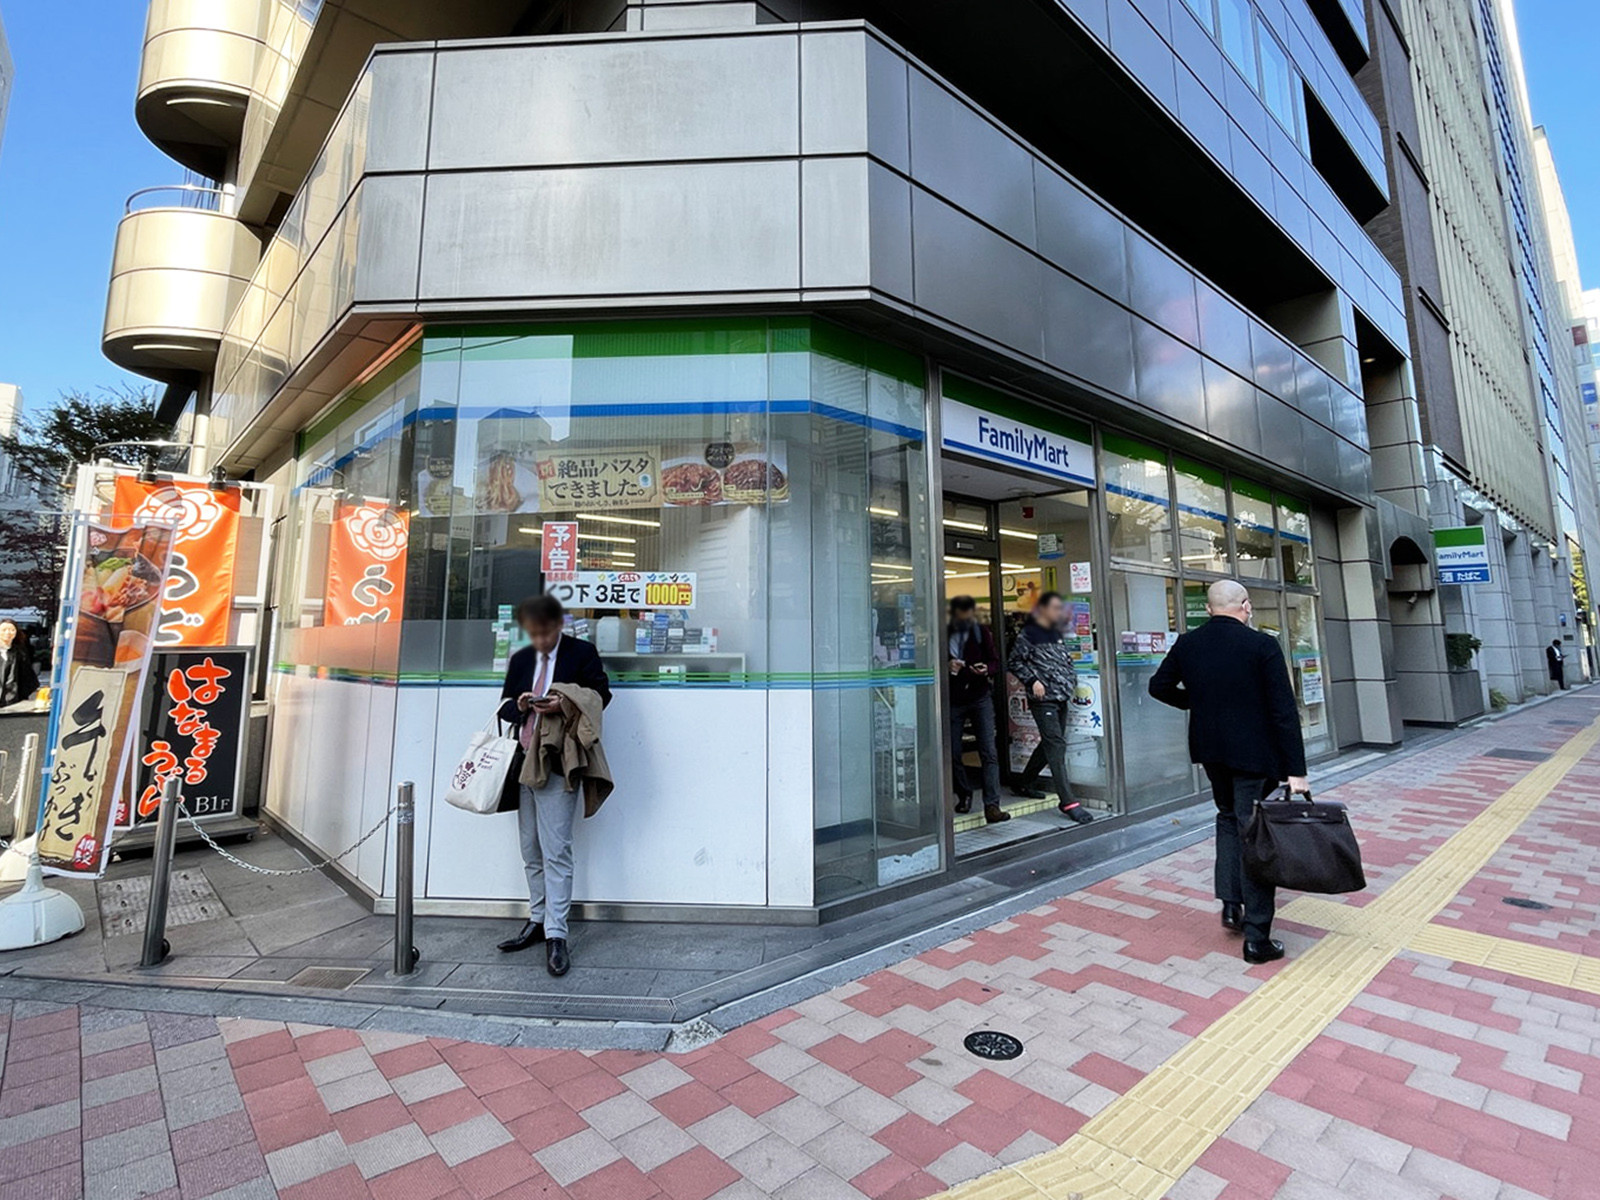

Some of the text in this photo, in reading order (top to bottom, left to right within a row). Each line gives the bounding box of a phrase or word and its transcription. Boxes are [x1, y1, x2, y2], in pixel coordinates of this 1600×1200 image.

[978, 415, 1069, 468] FamilyMart
[557, 459, 649, 478] 絶品パスタ
[548, 479, 645, 499] できました。
[548, 525, 572, 571] 予告
[1438, 551, 1484, 559] amilyMart
[1456, 571, 1482, 581] たばこ
[595, 584, 640, 604] 3足で
[646, 585, 693, 605] 1000円
[168, 657, 231, 785] はなまる
[194, 795, 230, 815] B1F
